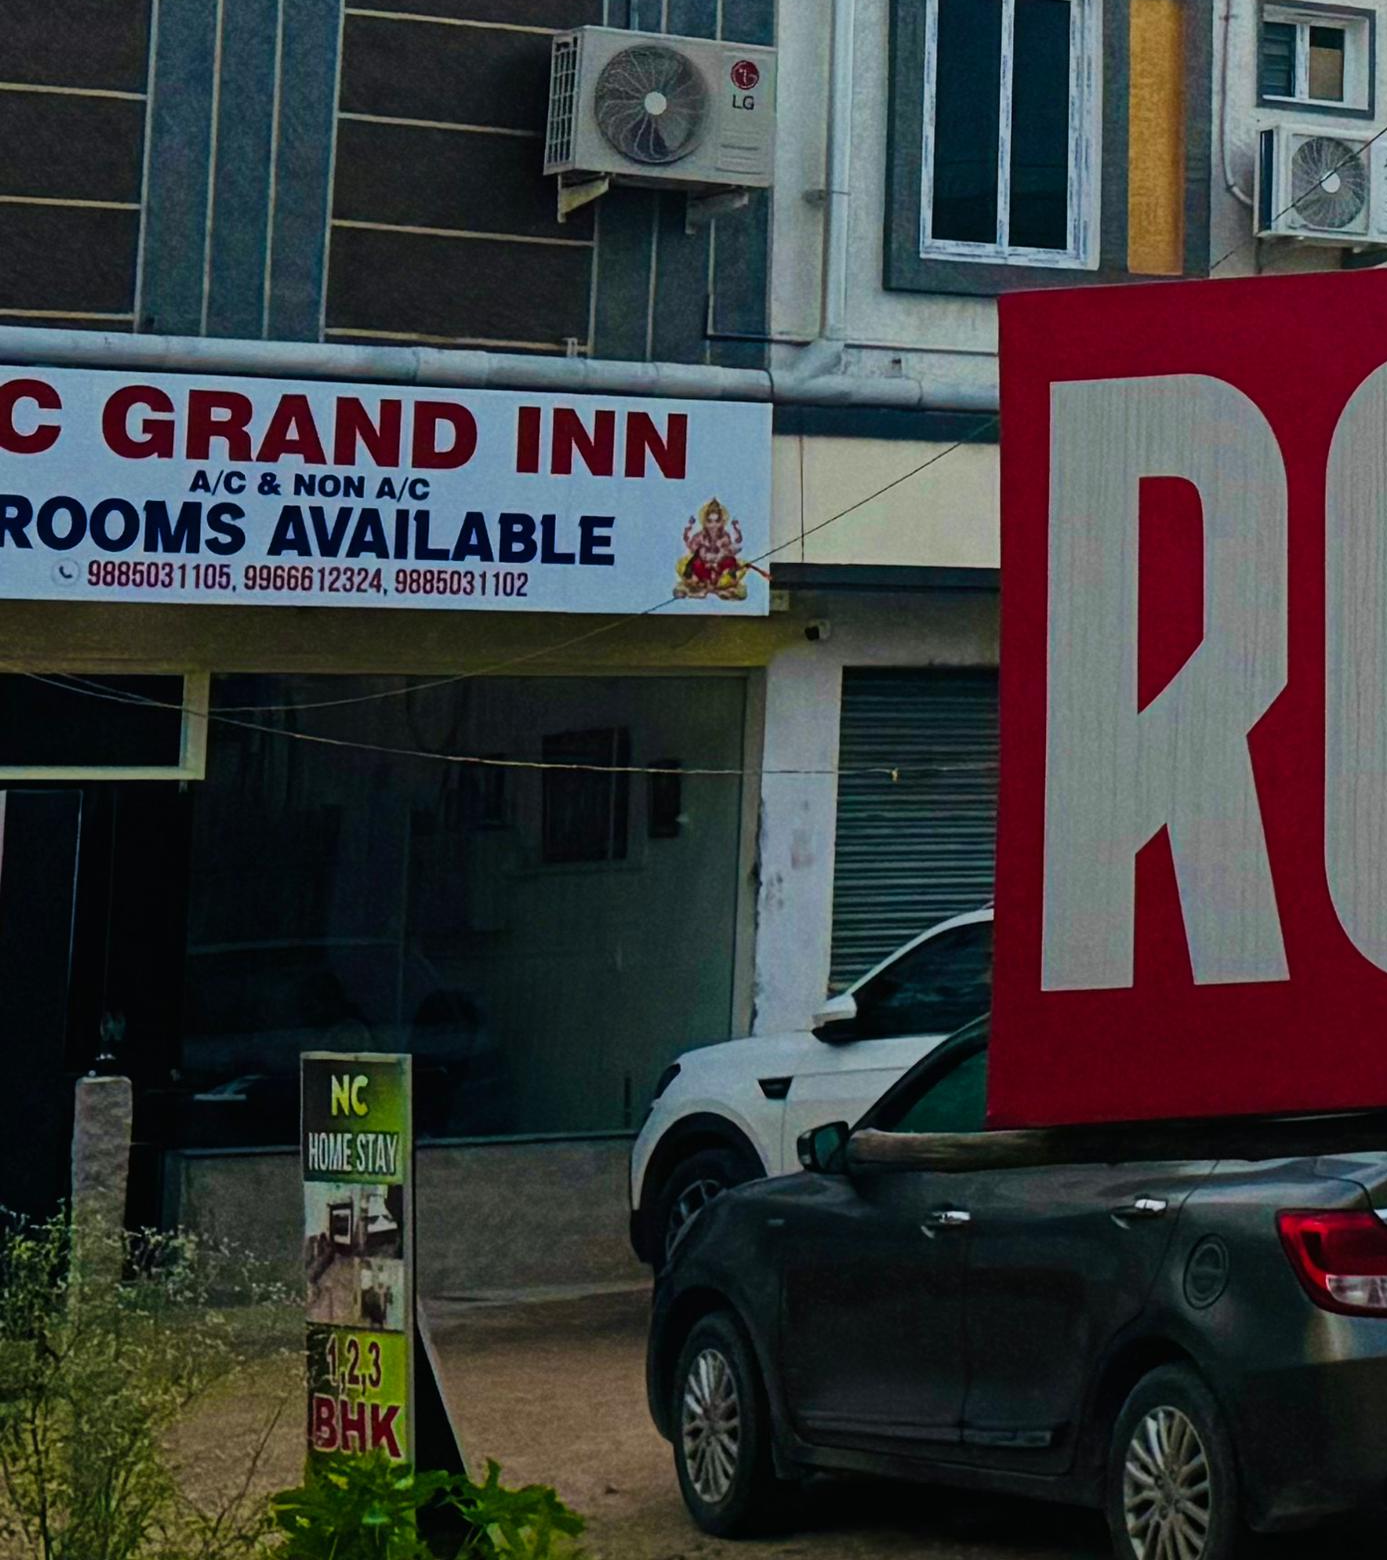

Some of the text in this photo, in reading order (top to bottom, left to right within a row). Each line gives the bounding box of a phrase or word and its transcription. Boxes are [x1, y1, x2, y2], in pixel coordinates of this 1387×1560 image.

[731, 94, 755, 111] LG
[0, 378, 689, 480] C GRAND INN
[189, 469, 431, 502] A/C & NON A/C
[0, 494, 616, 566] ROOMS AVAILABLE
[87, 560, 529, 597] 9885031105, 9966612324, 9885031102
[331, 1074, 369, 1117] NC
[308, 1132, 398, 1174] HOME STAY
[313, 1392, 404, 1460] BHK
